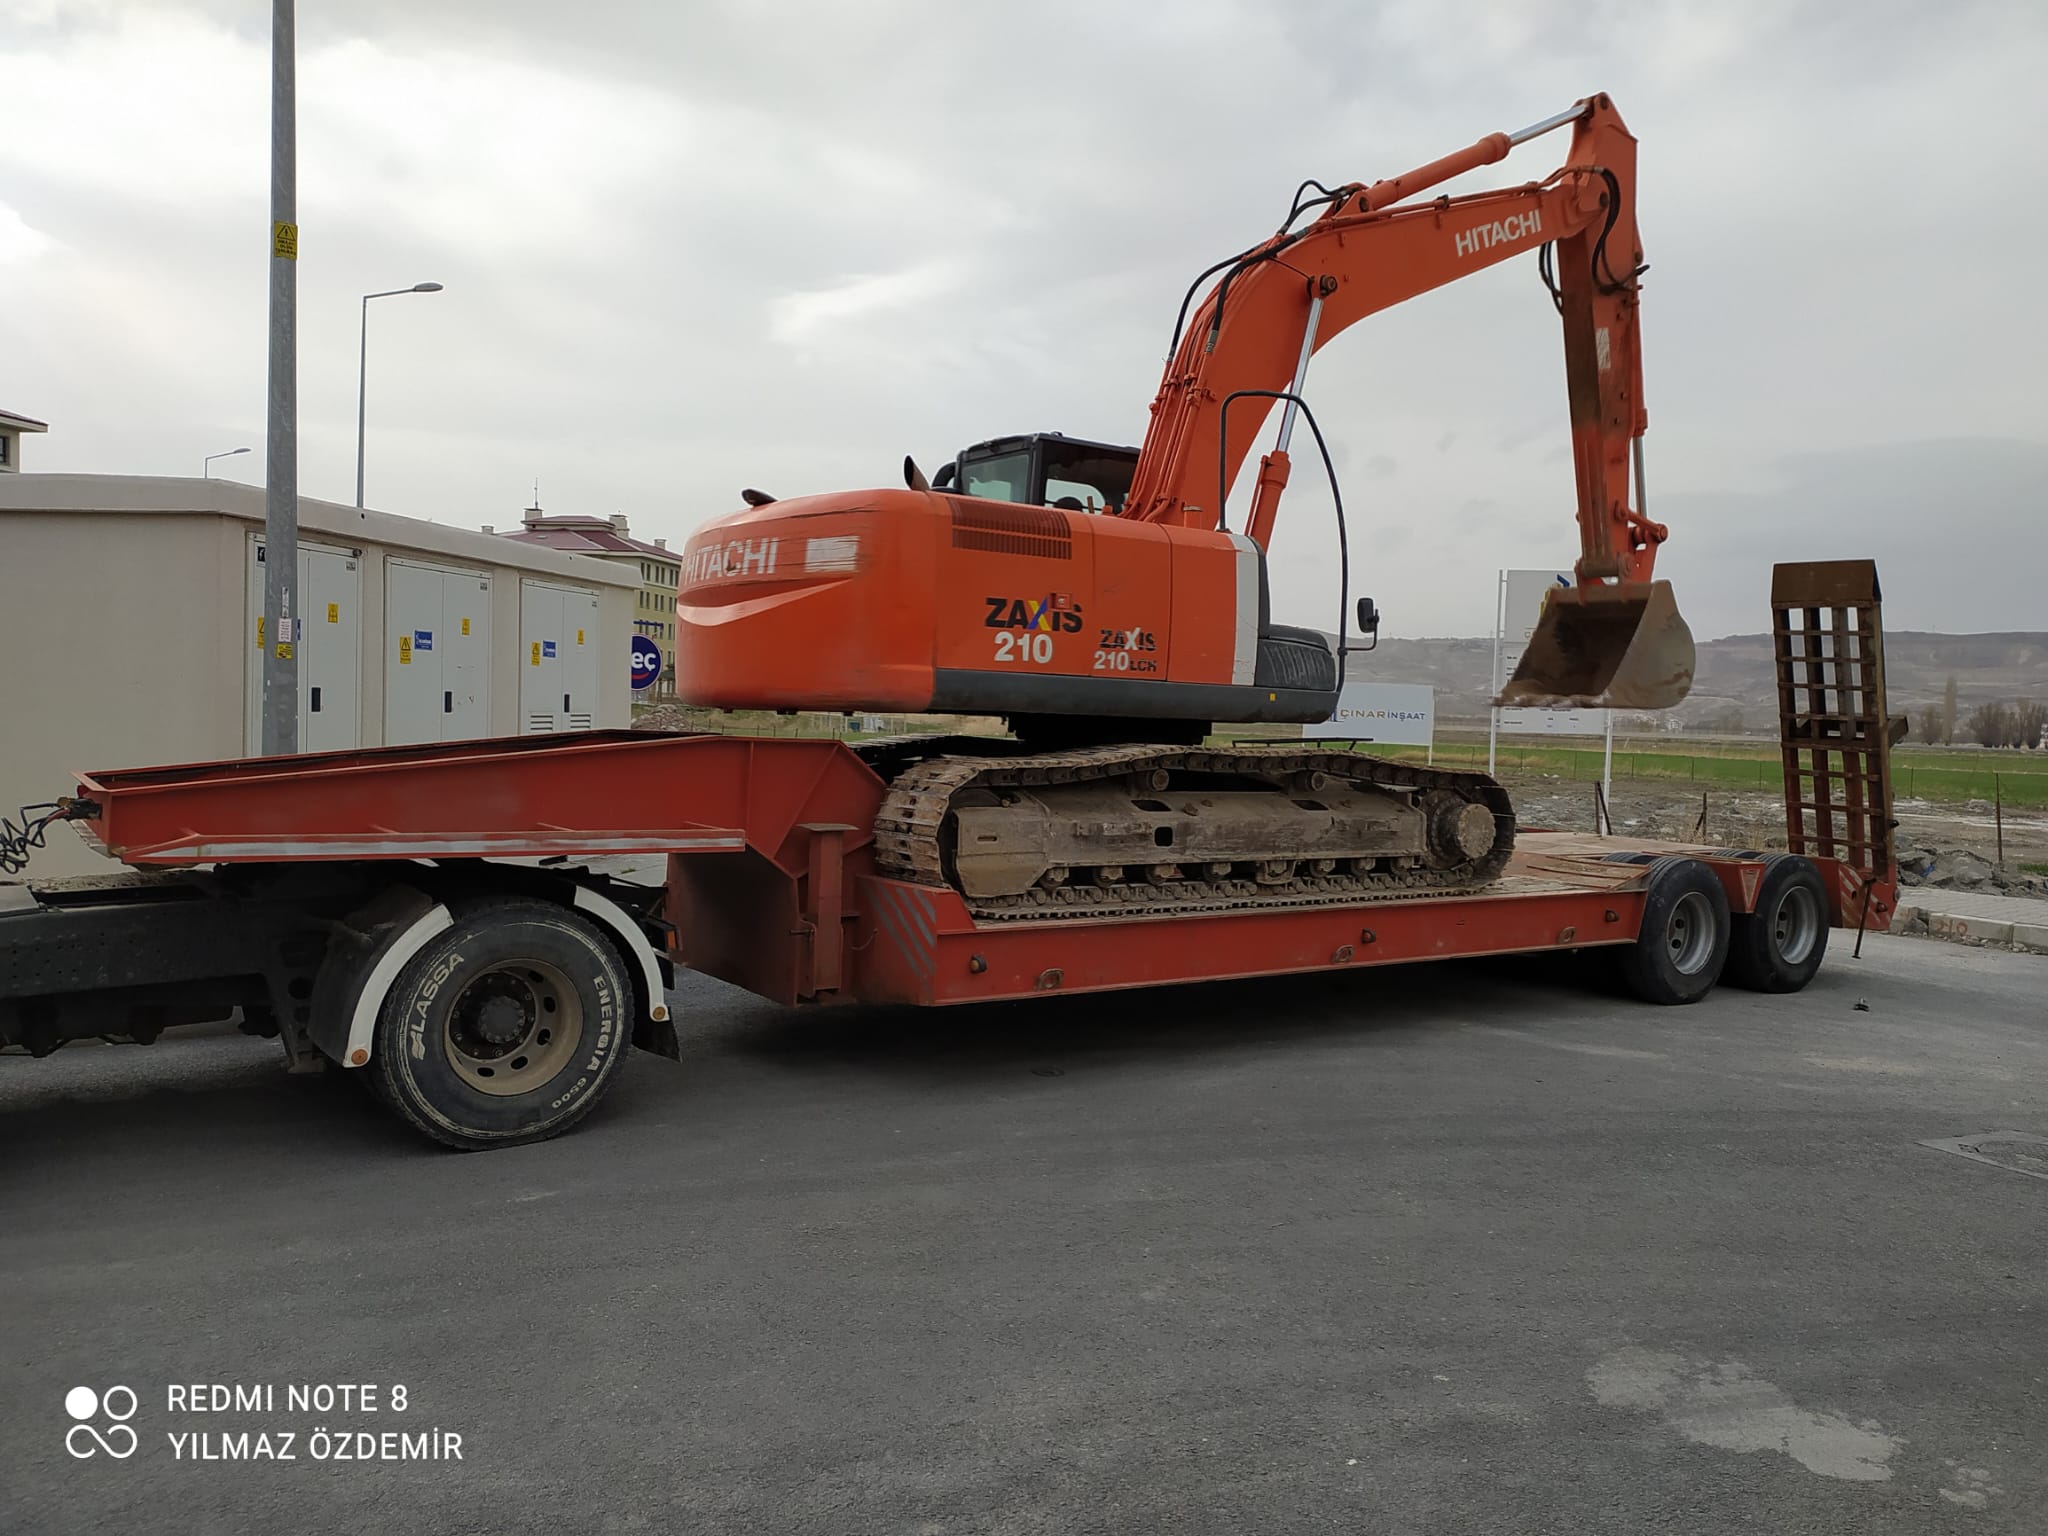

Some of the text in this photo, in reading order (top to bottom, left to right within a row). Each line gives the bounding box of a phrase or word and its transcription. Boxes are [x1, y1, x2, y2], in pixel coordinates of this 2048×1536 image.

[1455, 208, 1541, 257] HITACHI
[682, 537, 779, 585] HITACHI
[984, 597, 1083, 633] ZAXIS
[994, 631, 1053, 664] 210
[1099, 627, 1156, 651] ZAXIS
[631, 651, 656, 671] eç
[411, 953, 464, 1033] LASSA
